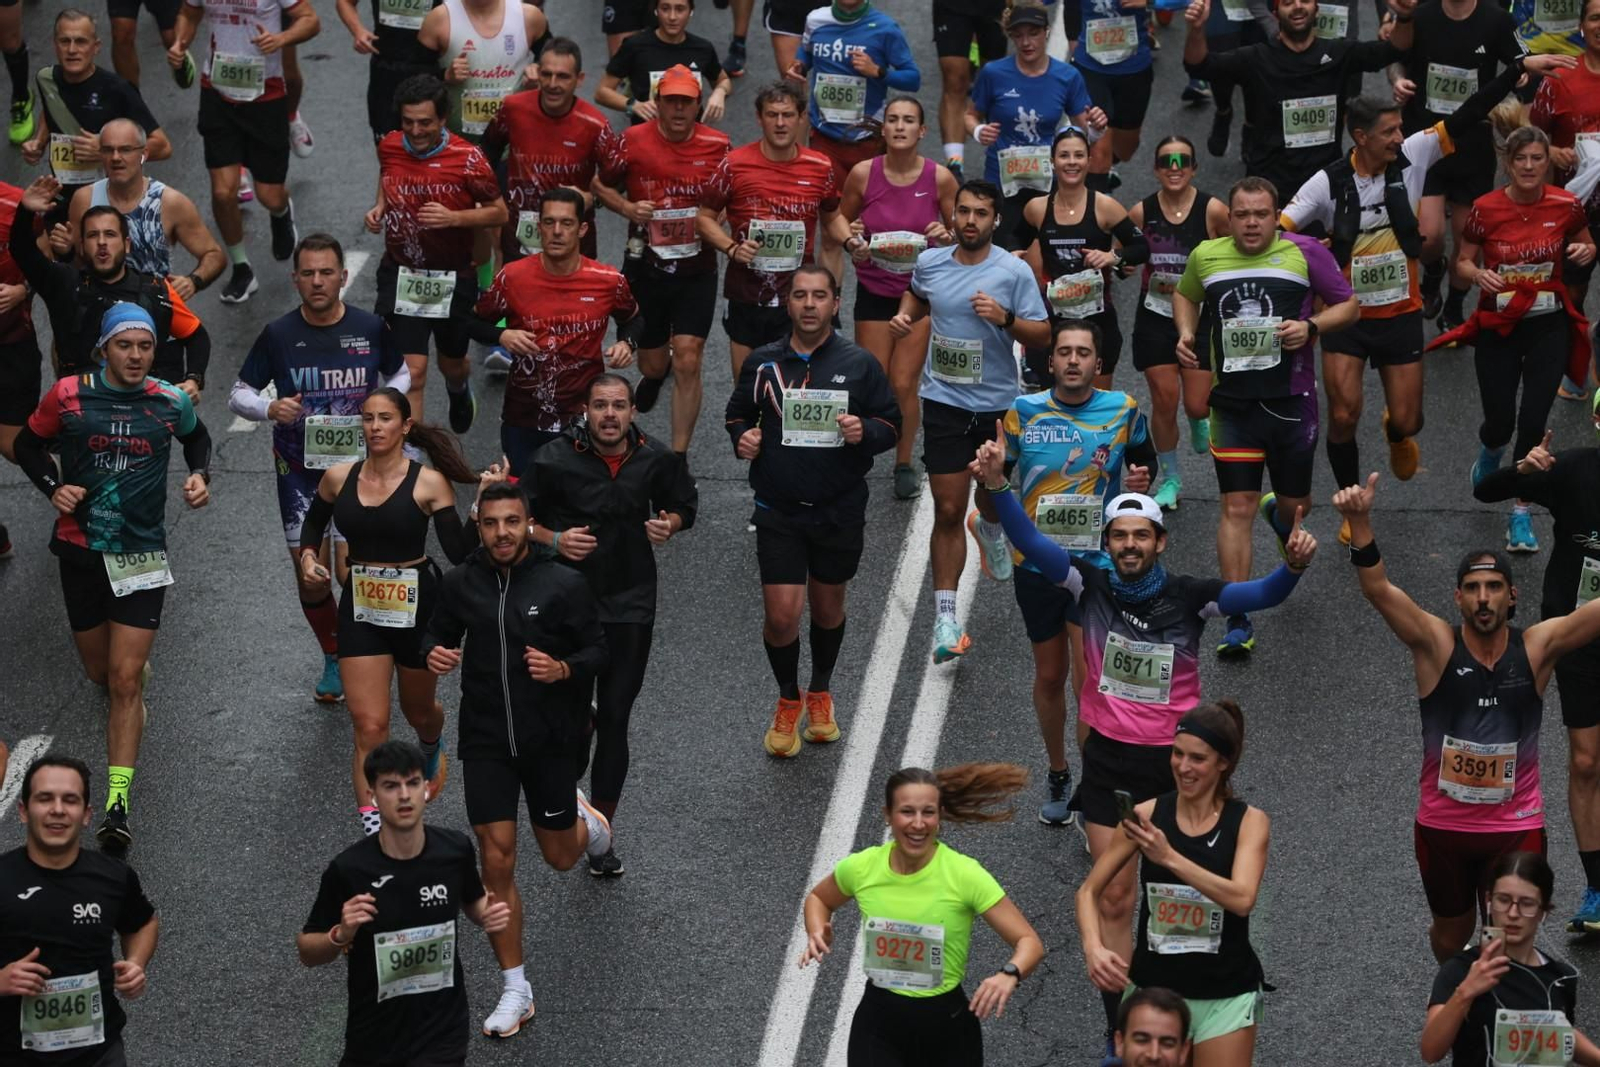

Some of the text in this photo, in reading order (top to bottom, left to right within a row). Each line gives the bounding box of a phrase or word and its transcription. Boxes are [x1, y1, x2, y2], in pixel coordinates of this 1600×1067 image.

[1543, 0, 1574, 14] 9231
[1093, 28, 1124, 45] 6722
[813, 42, 831, 57] FIS
[221, 65, 252, 81] 8511
[1433, 76, 1468, 95] 7216
[821, 87, 853, 103] 8856
[1292, 109, 1325, 125] 9409
[665, 184, 702, 196] MARA
[662, 222, 687, 237] 572
[1360, 265, 1396, 285] 8812
[407, 279, 441, 297] 7683
[1230, 330, 1268, 349] 9897
[936, 348, 968, 369] 8949
[290, 366, 368, 391] VII TRAIL
[792, 403, 833, 421] 8237
[315, 429, 353, 446] 6923
[1024, 430, 1083, 444] SEVILLA
[1046, 508, 1088, 526] 8465
[358, 580, 407, 602] 12676
[1113, 651, 1153, 677] 6571
[1452, 754, 1497, 778] 3591
[419, 884, 449, 902] SVQ
[73, 902, 102, 919] SVQ
[1157, 901, 1205, 927] 9270
[389, 943, 438, 971] 9805
[875, 936, 925, 961] 9272
[34, 994, 86, 1020] 9846
[1508, 1029, 1559, 1053] 9714
